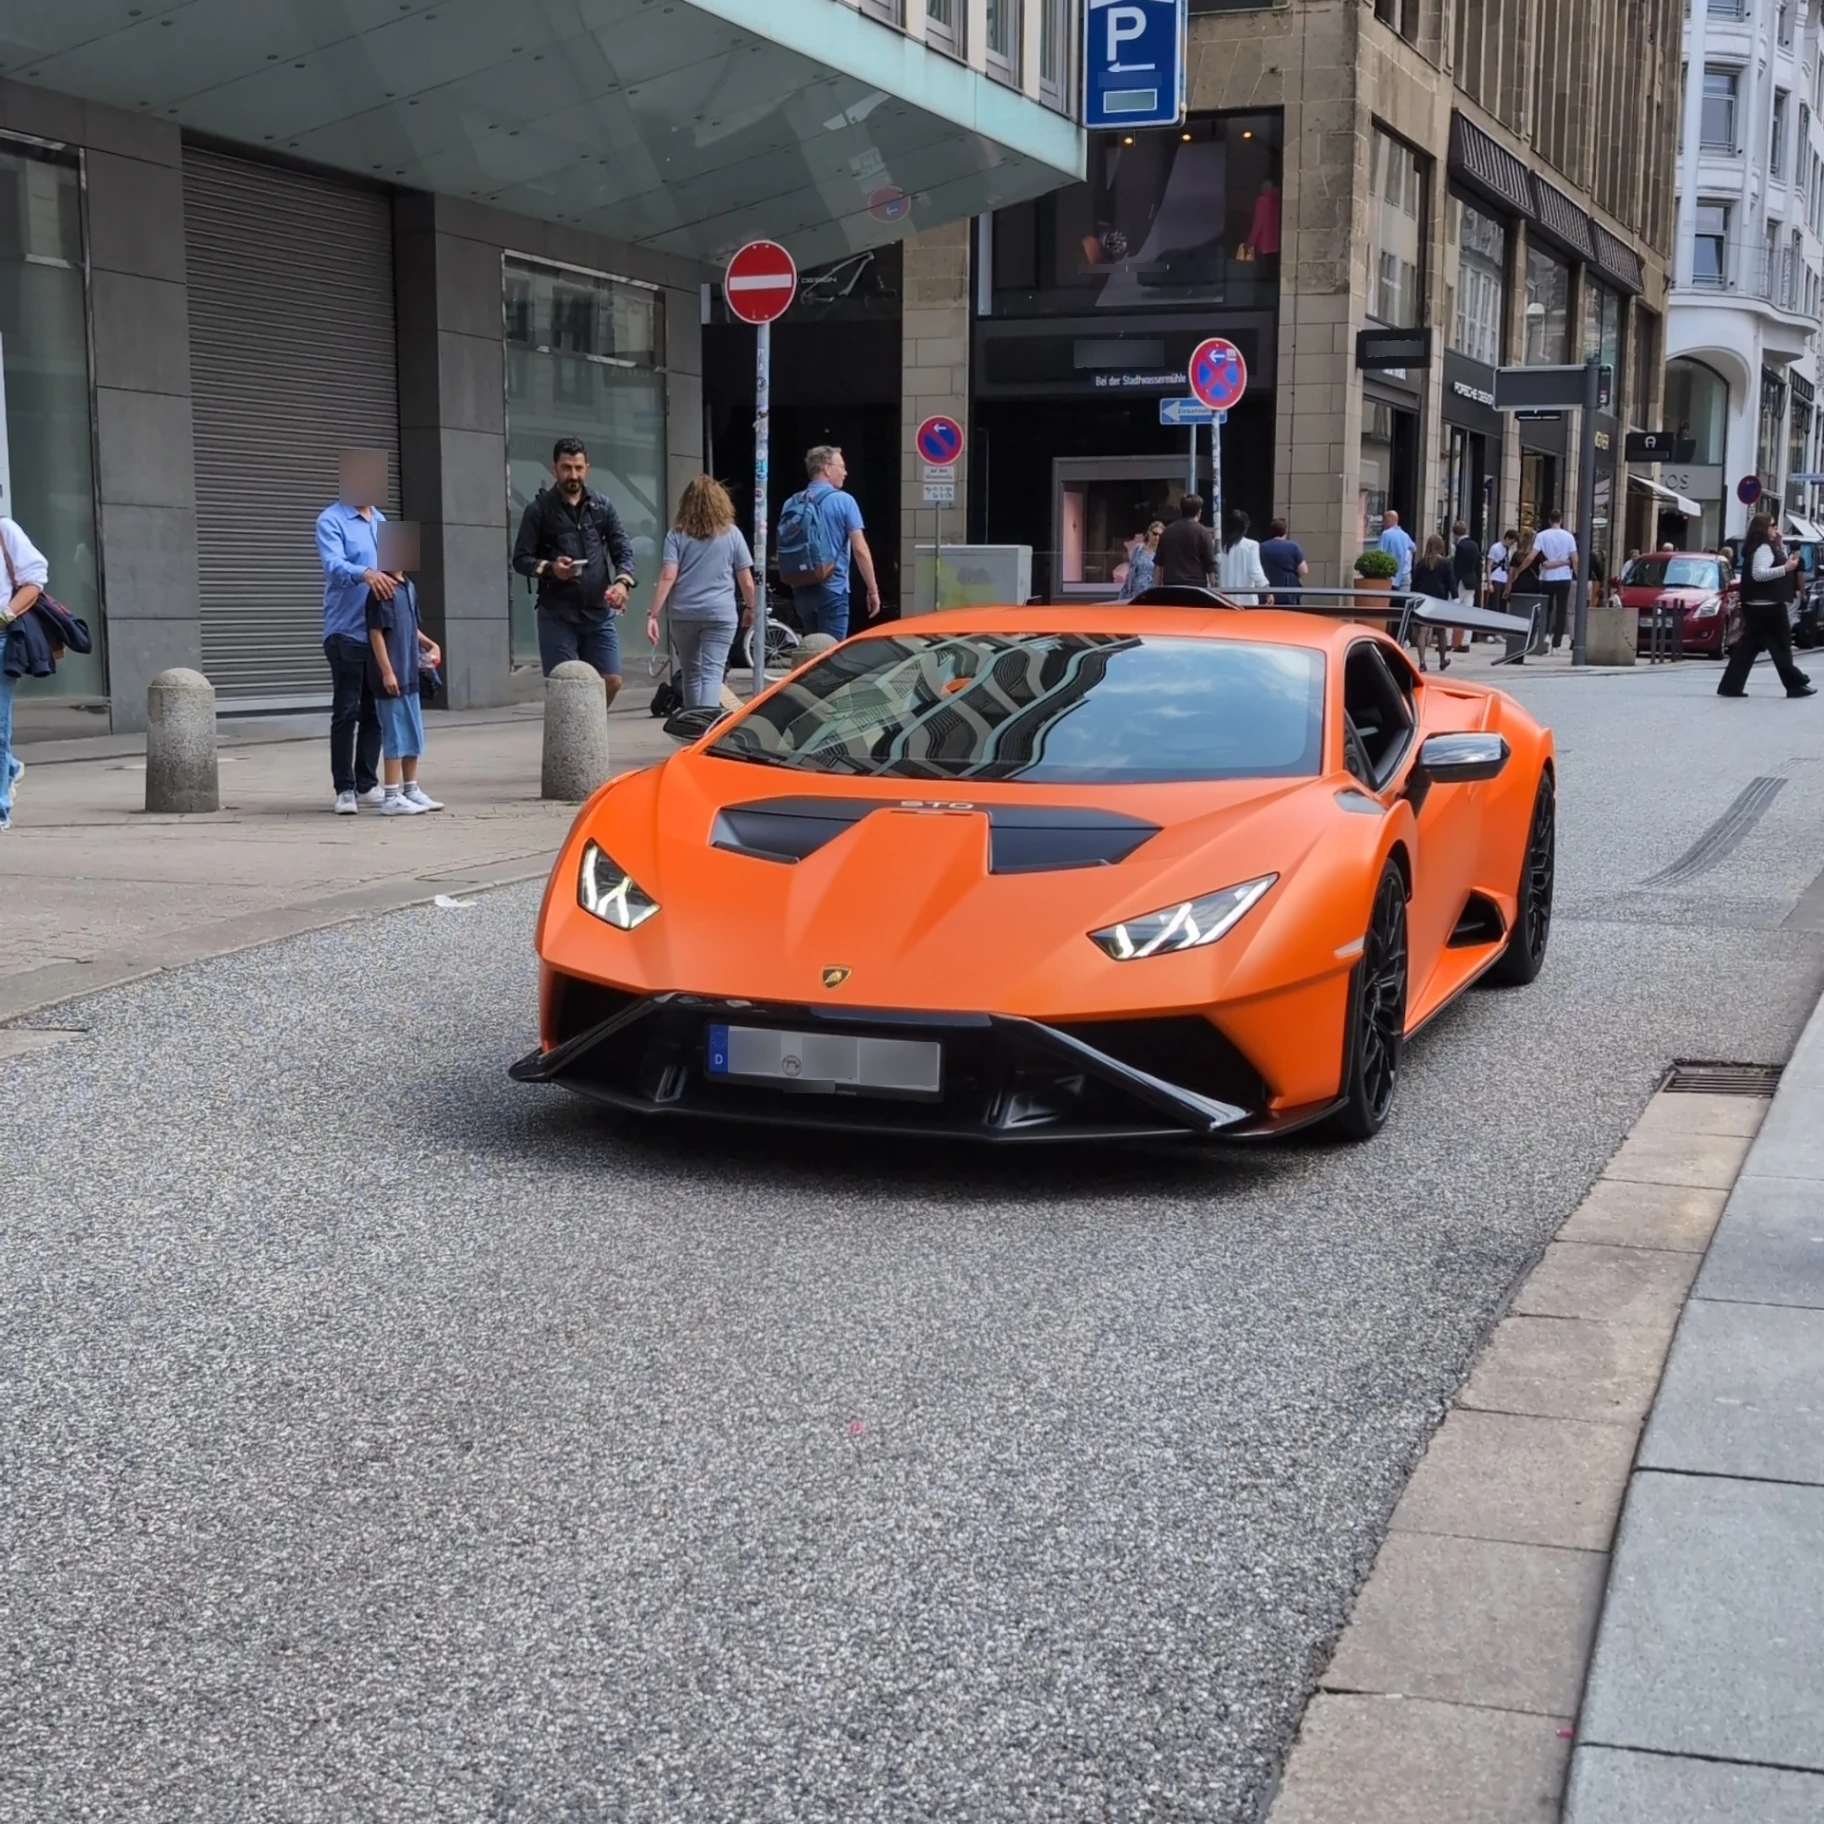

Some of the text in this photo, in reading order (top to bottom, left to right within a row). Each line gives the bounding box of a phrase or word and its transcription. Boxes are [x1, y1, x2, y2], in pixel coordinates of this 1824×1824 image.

[1107, 6, 1147, 61] P
[1095, 375, 1108, 387] Bei
[1108, 375, 1121, 386] der
[900, 800, 974, 810] STO
[715, 1053, 724, 1065] D
